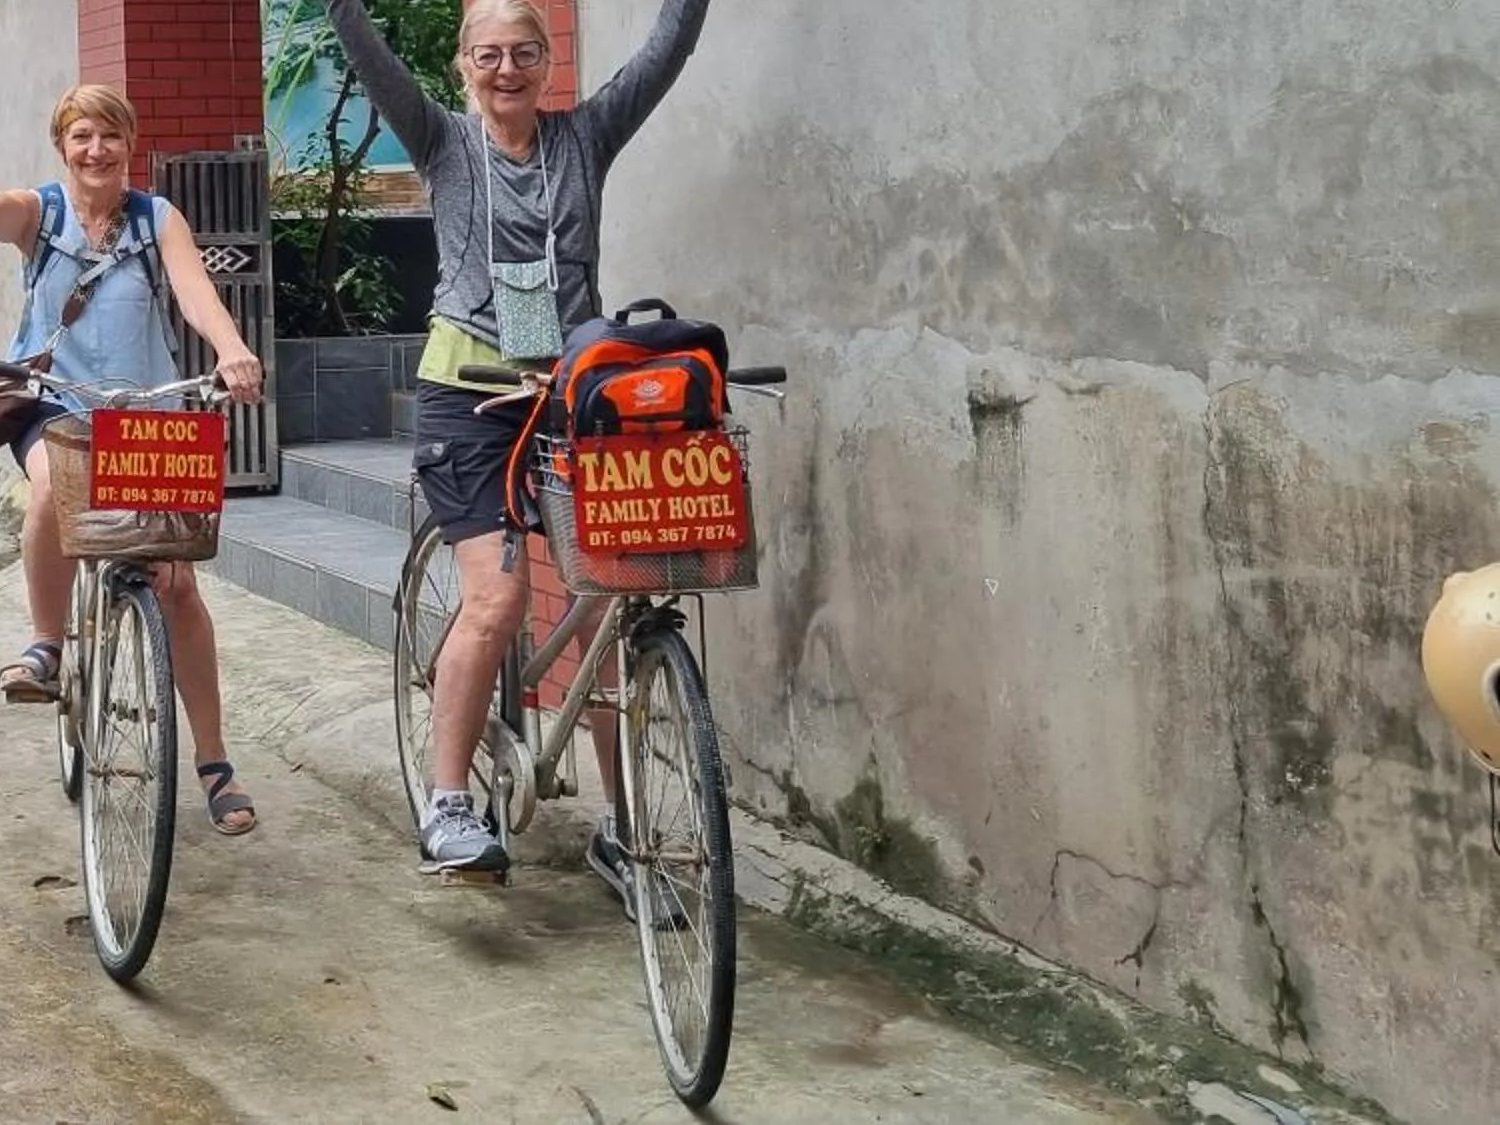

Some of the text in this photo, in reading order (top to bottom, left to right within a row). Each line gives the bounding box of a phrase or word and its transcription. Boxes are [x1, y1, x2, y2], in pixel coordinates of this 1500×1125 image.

[120, 418, 198, 442] TAM COC
[97, 451, 217, 479] FAMILY HOTEL
[578, 450, 654, 492] TAM
[121, 488, 147, 502] 094
[151, 489, 178, 503] 367
[182, 490, 215, 504] 7874
[584, 494, 735, 524] FAMILY HOTEL
[621, 528, 653, 544] 094
[657, 527, 689, 542] 367
[695, 525, 736, 540] 7874
